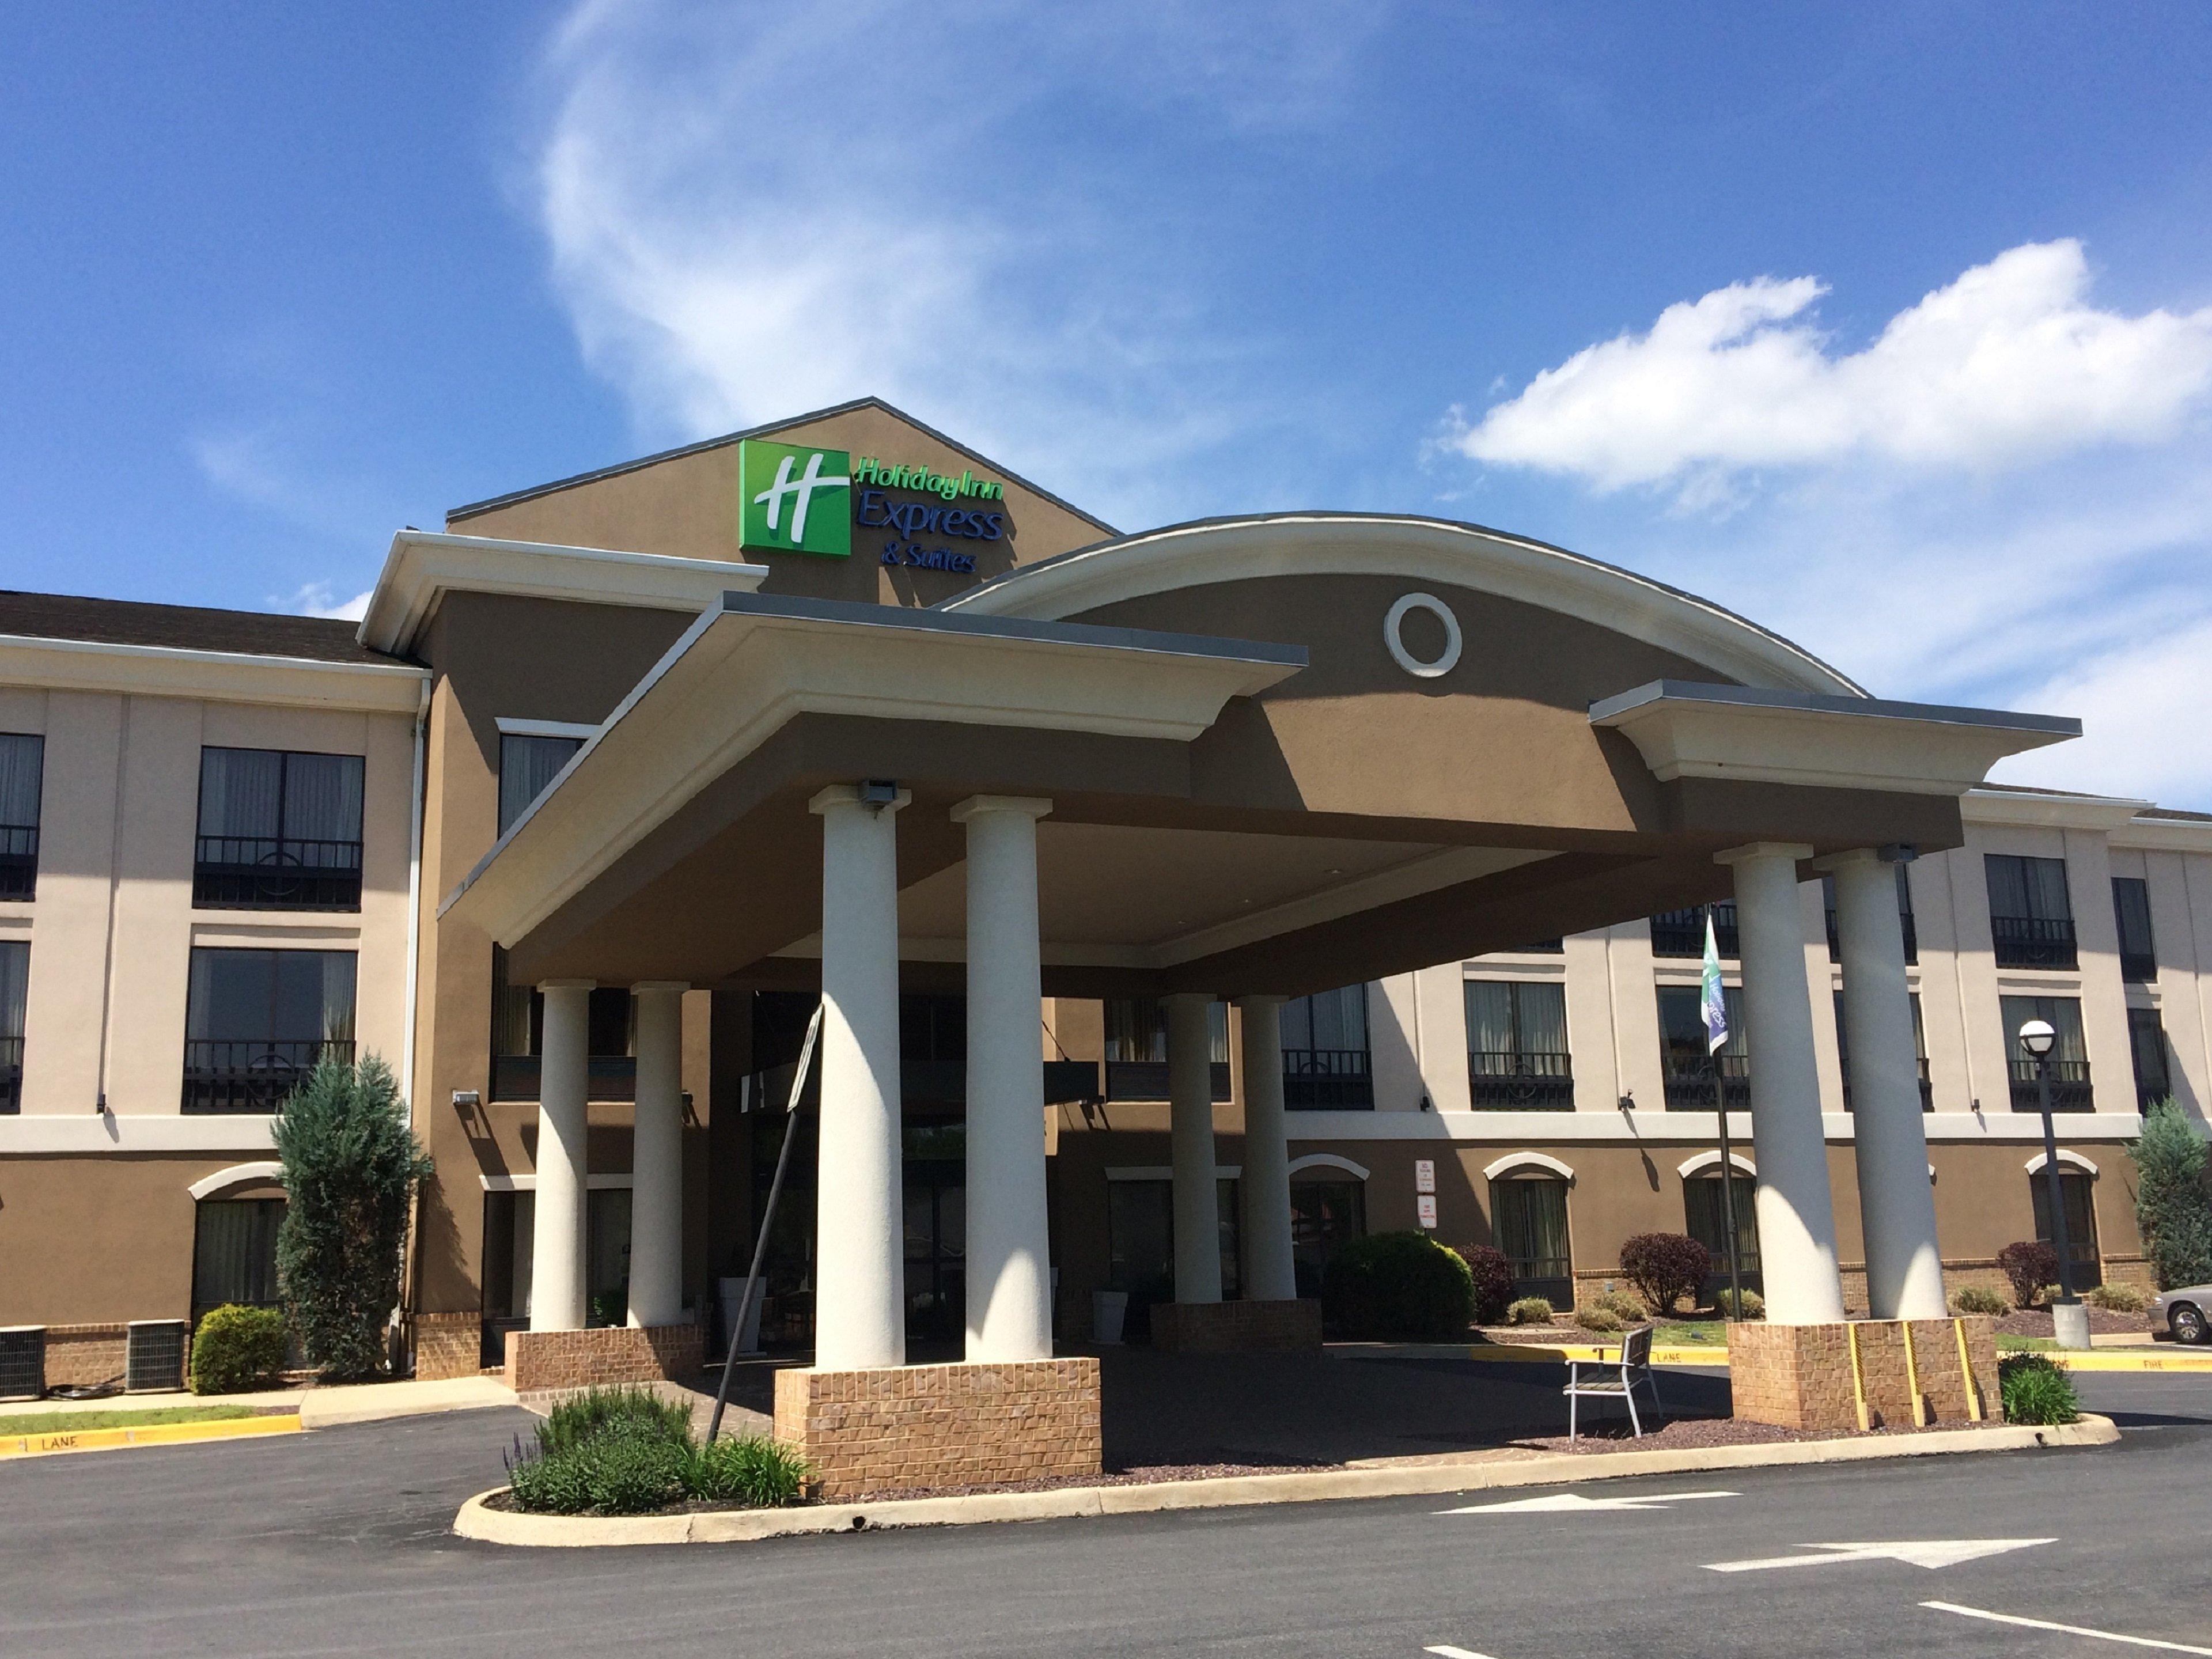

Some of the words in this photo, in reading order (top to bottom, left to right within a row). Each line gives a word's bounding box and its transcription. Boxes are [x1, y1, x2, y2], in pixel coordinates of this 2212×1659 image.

[854, 456, 960, 501] Holiday
[960, 470, 1003, 501] Inn
[858, 490, 1004, 541] Express
[881, 540, 901, 565] &
[906, 543, 977, 573] Suites
[1657, 1353, 1681, 1363] LANE
[2143, 1359, 2163, 1369] FIRE
[41, 1435, 78, 1451] LANE
